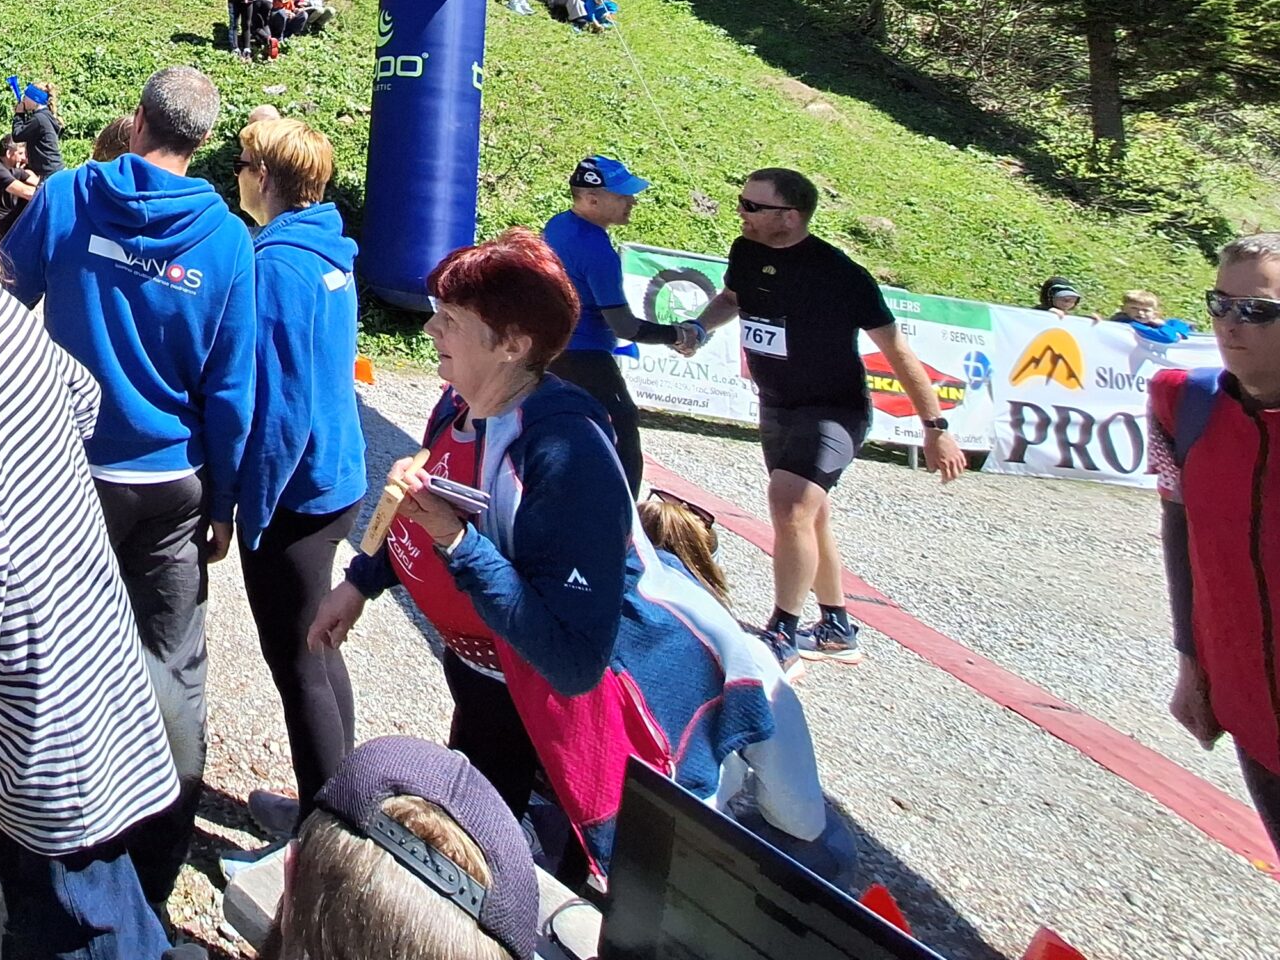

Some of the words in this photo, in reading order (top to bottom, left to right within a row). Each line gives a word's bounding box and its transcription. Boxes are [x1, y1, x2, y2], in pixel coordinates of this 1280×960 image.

[744, 325, 777, 346] 767
[950, 330, 985, 346] SERVIS
[1095, 366, 1149, 393] Slove
[636, 389, 710, 408] www.dovzan.si
[1003, 400, 1148, 474] PRO
